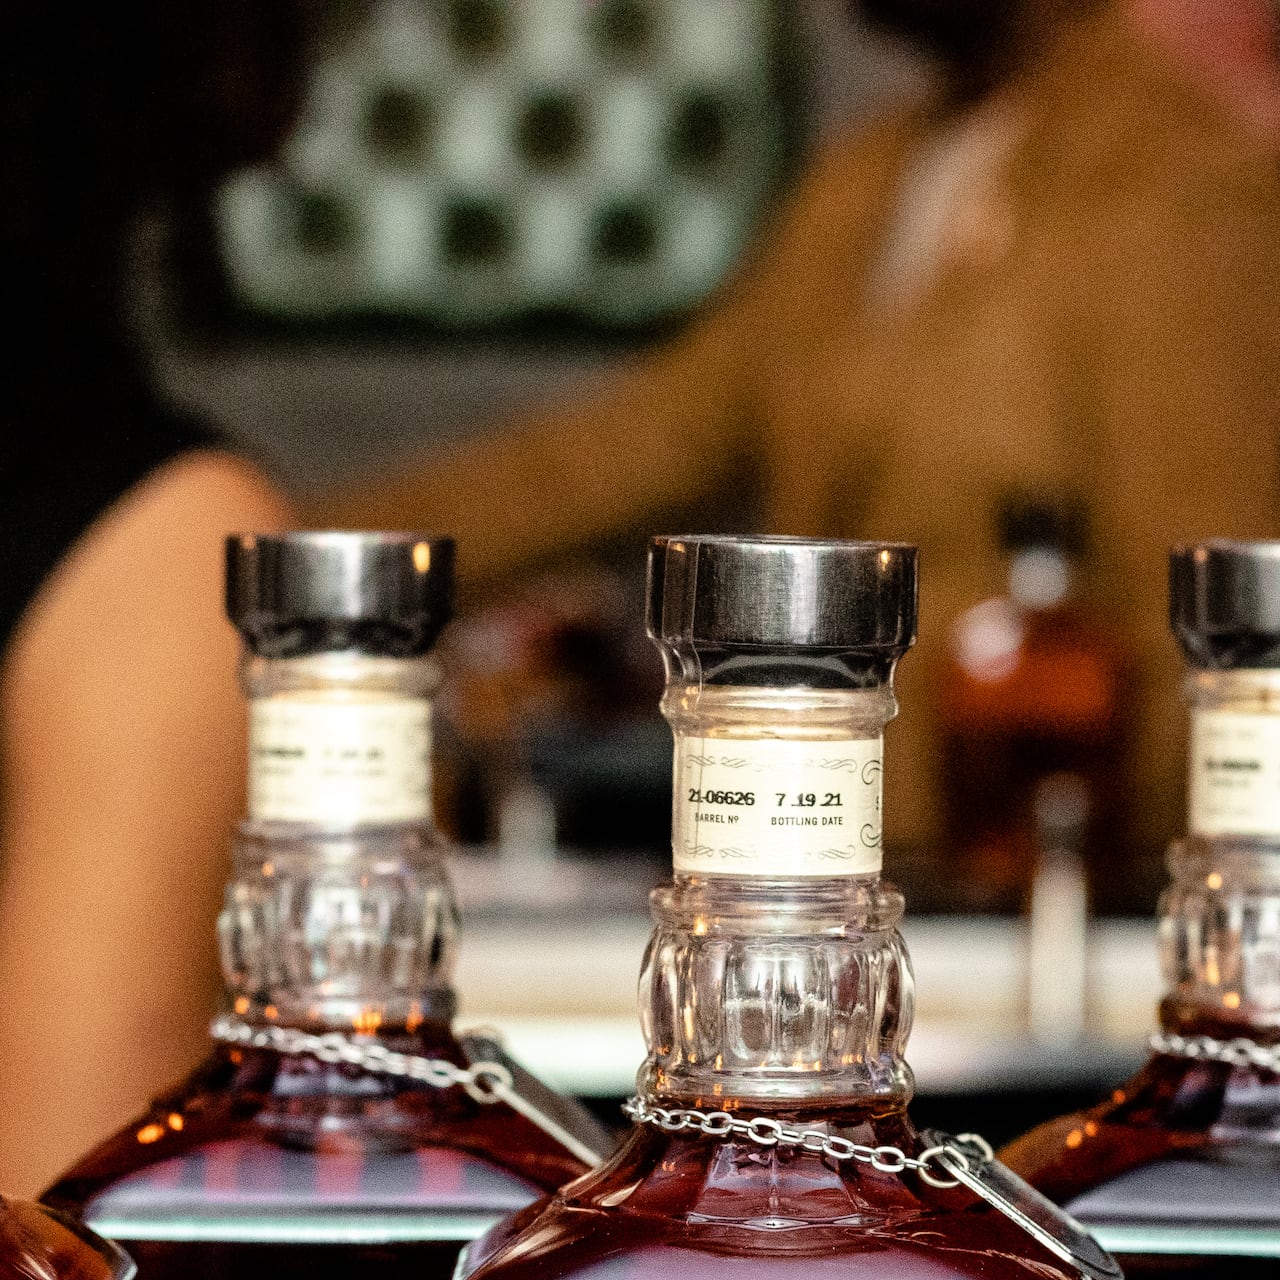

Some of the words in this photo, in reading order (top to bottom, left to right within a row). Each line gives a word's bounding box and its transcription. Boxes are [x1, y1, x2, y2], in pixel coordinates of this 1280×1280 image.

[688, 787, 756, 806] 21-06626
[695, 812, 725, 824] BARREL
[771, 816, 818, 826] BOTTLING
[821, 816, 844, 826] DATE
